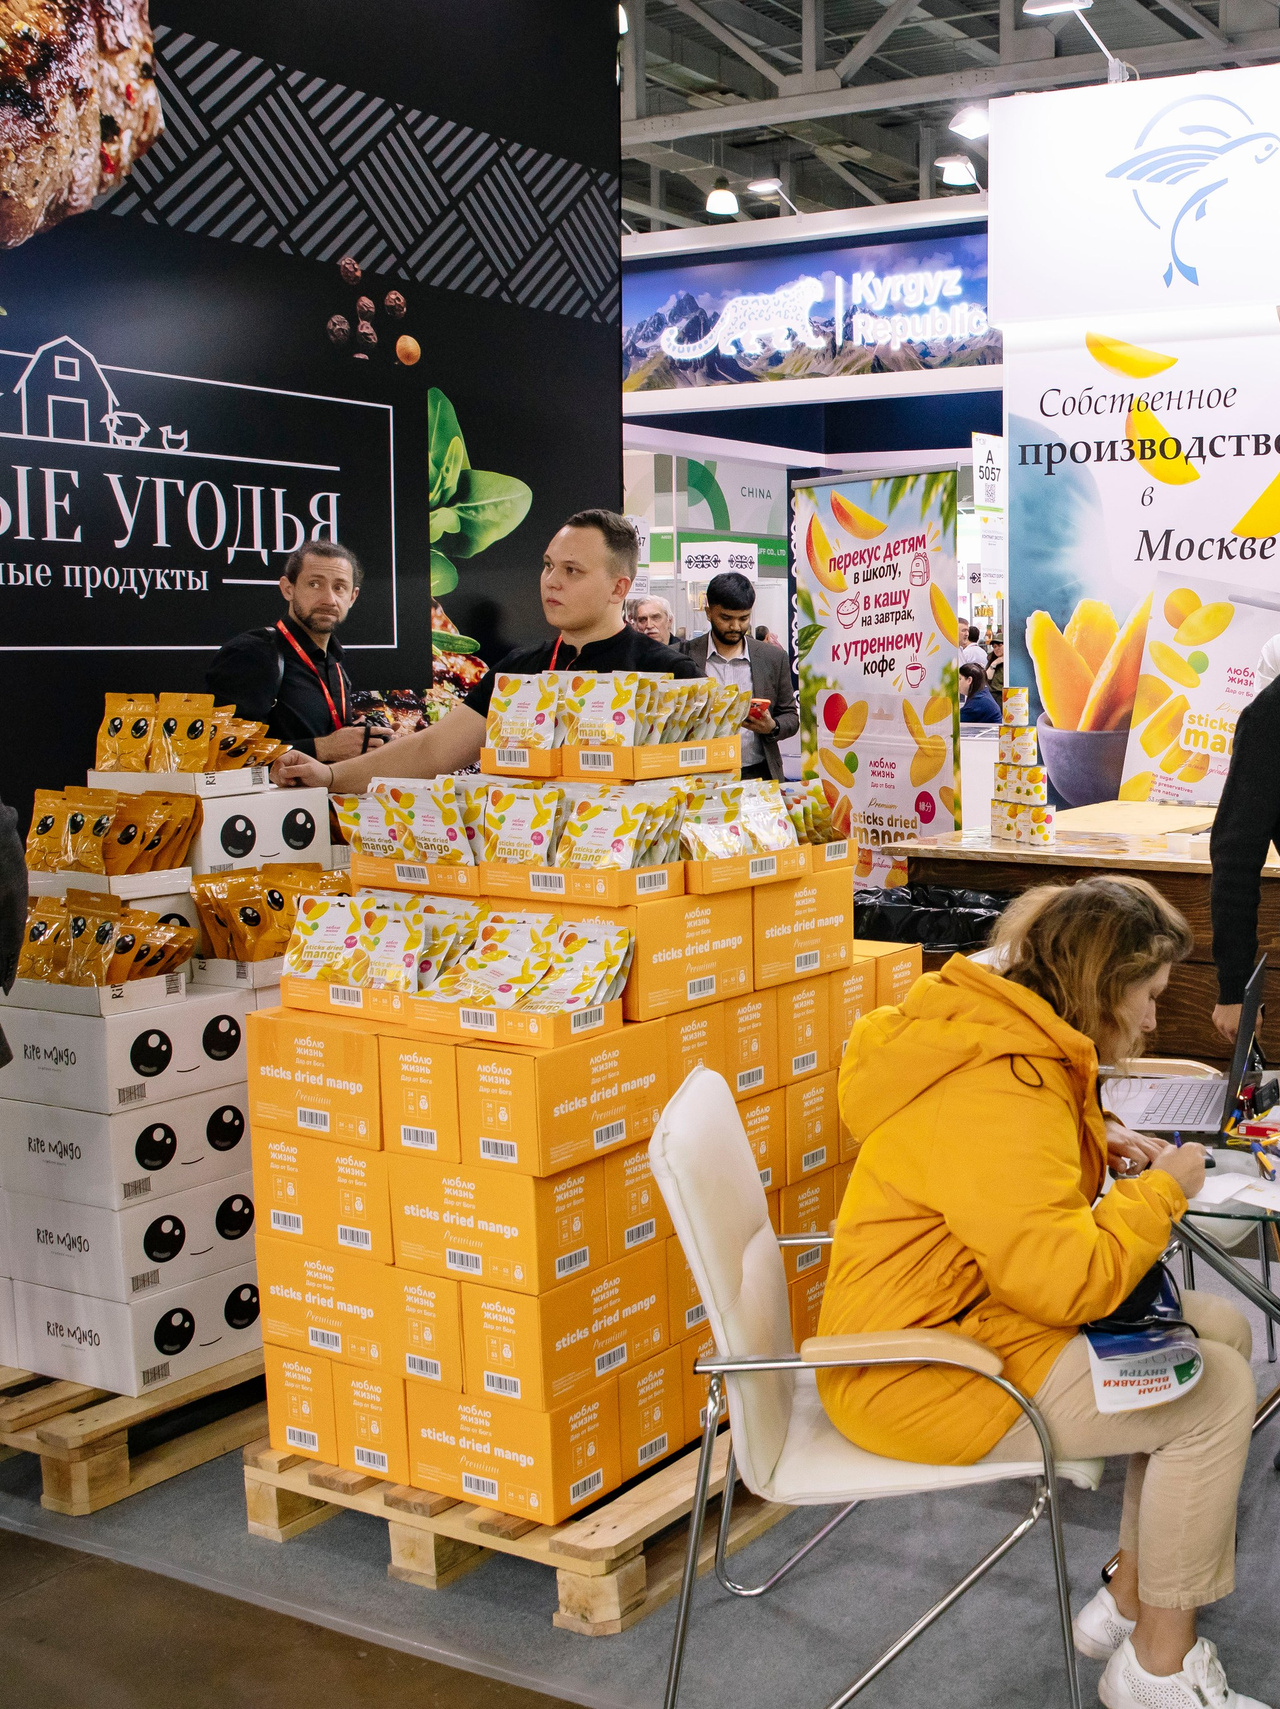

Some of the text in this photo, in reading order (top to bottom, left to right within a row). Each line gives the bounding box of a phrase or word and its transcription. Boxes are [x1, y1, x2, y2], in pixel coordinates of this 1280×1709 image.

[852, 269, 963, 311] Kyrgyz
[852, 305, 989, 351] Republic
[1040, 386, 1237, 418] Собственное
[986, 450, 994, 465] A
[978, 466, 1001, 482] 5057
[740, 486, 772, 500] CHINA
[1141, 486, 1154, 507] в
[103, 472, 341, 566] УГОДЬЯ
[829, 534, 926, 576] перекус детям
[1134, 529, 1277, 562] Москве
[853, 561, 901, 584] в школу,
[63, 565, 209, 600] продукты
[864, 589, 910, 614] в кашу
[861, 609, 915, 627] на завтрак,
[832, 632, 923, 664] к утреннему
[863, 655, 895, 676] кофе
[1227, 667, 1255, 678] любл
[1228, 676, 1254, 687] жизн
[1188, 713, 1236, 733] sticks
[869, 758, 896, 770] люблю
[870, 770, 895, 779] жизнь
[852, 812, 918, 829] sticks dried
[765, 913, 844, 939] sticks dried mango
[303, 950, 343, 960] mango
[294, 1036, 324, 1049] люблю
[296, 1047, 323, 1058] жизнь
[589, 1049, 620, 1065] люблю
[591, 1060, 618, 1074] жизнь
[260, 1065, 363, 1095] sticks dried mango
[553, 1073, 656, 1117] sticks dried mango
[1103, 1376, 1169, 1388] ВЫСТАВКИ
[1120, 1368, 1167, 1377] ВНУТРИ
[1138, 1383, 1172, 1395] ПЛАН
[421, 1427, 535, 1467] sticks dried mango
